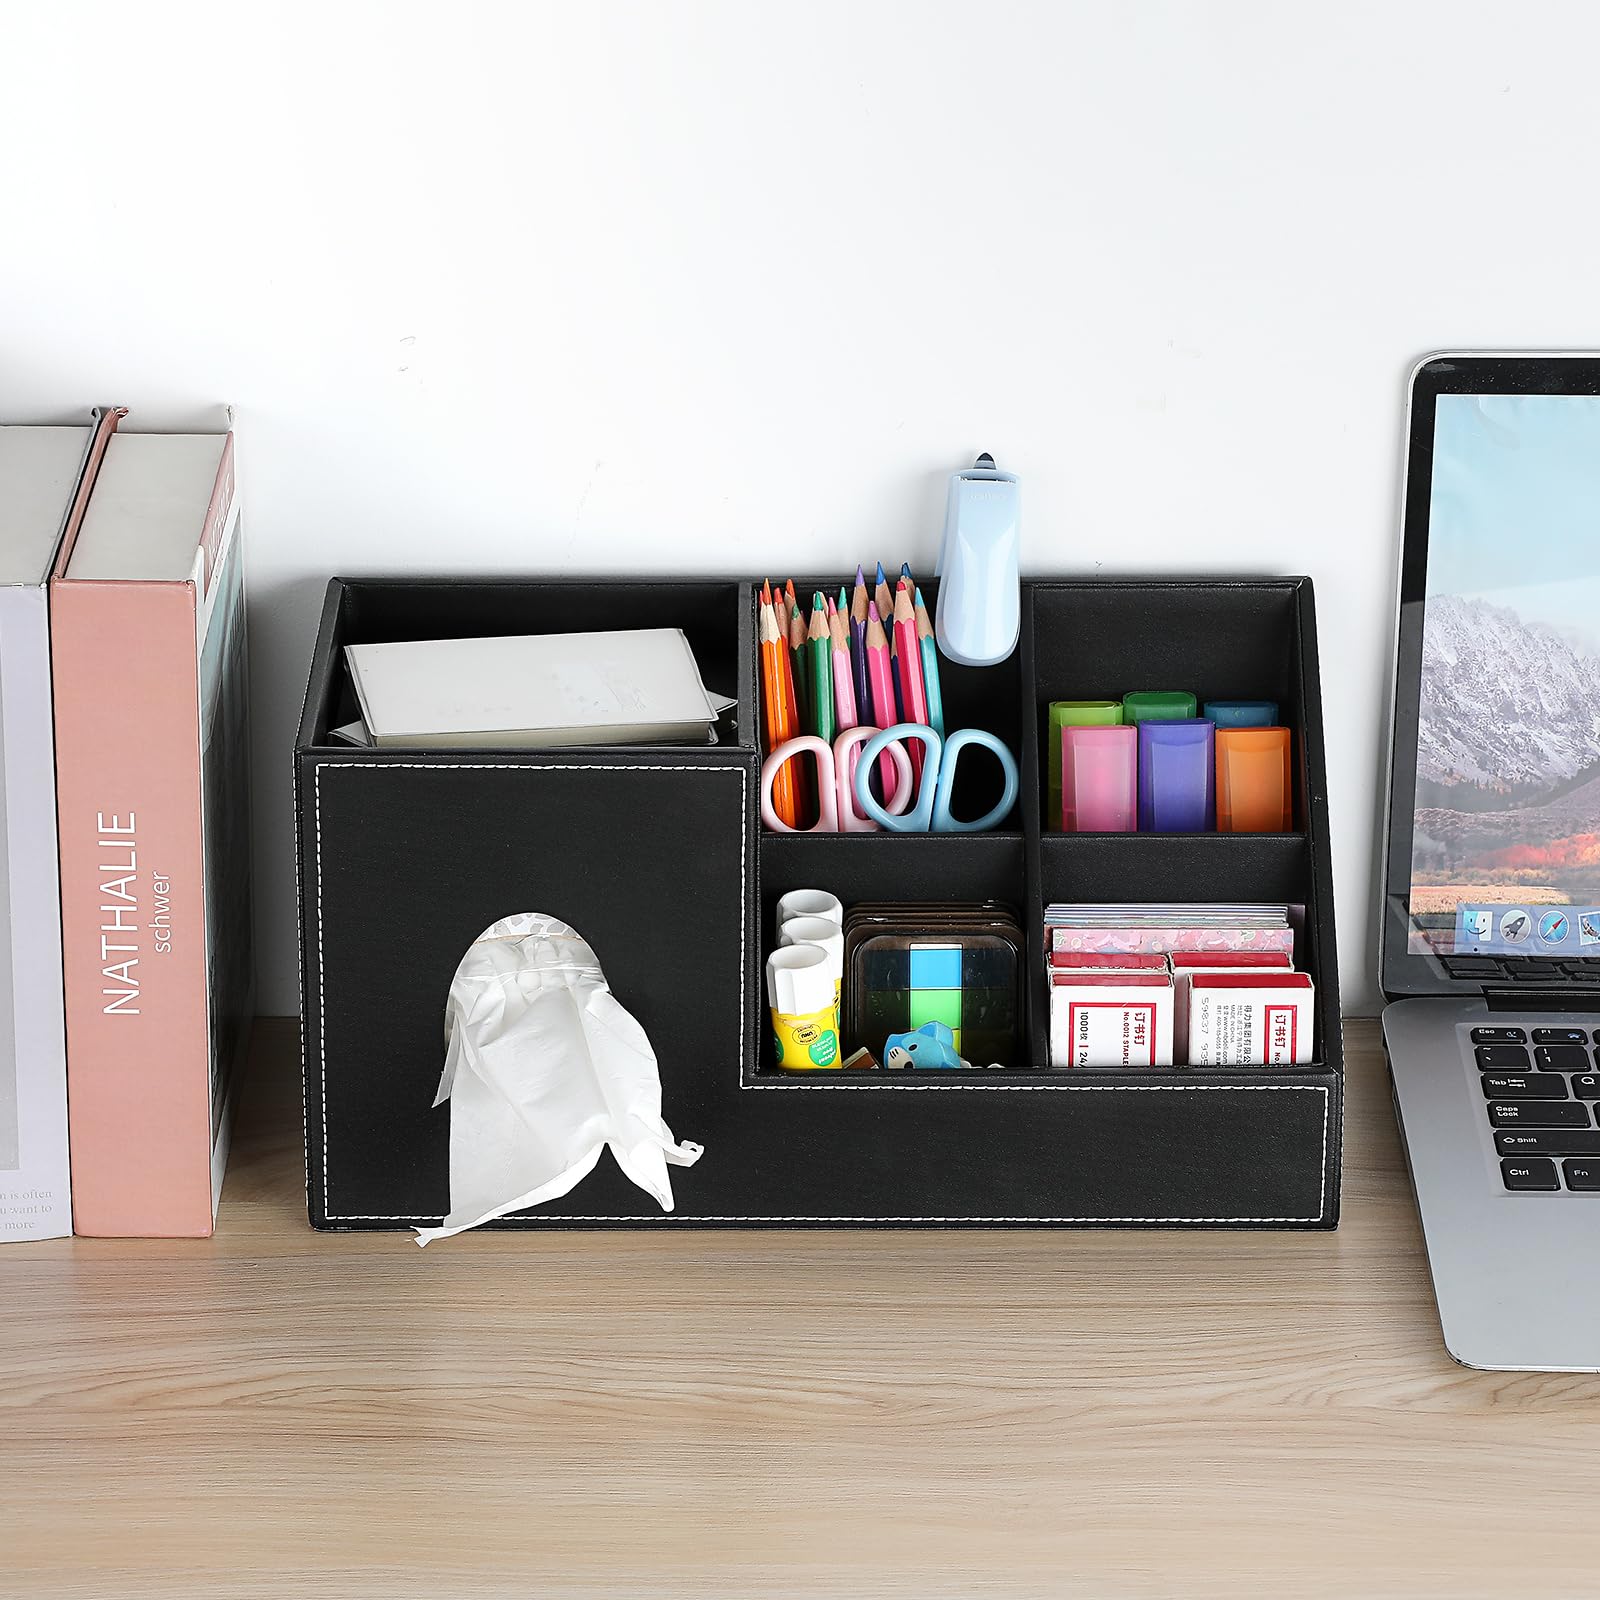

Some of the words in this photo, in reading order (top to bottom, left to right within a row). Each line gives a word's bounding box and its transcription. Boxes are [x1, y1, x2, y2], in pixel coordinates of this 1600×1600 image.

[97, 812, 141, 1015] NATHALIE
[148, 870, 172, 953] schwer
[1122, 1011, 1130, 1038] No.0012
[1134, 1012, 1146, 1046] 订书钉
[1274, 1014, 1287, 1048] 订书钉
[1122, 1040, 1130, 1067] STAPLE
[1581, 1076, 1595, 1085] Q
[1509, 1168, 1529, 1176] Ctrl
[1573, 1169, 1589, 1177] Fn
[22, 1189, 52, 1200] often
[41, 1205, 52, 1213] to
[5, 1222, 35, 1230] more
